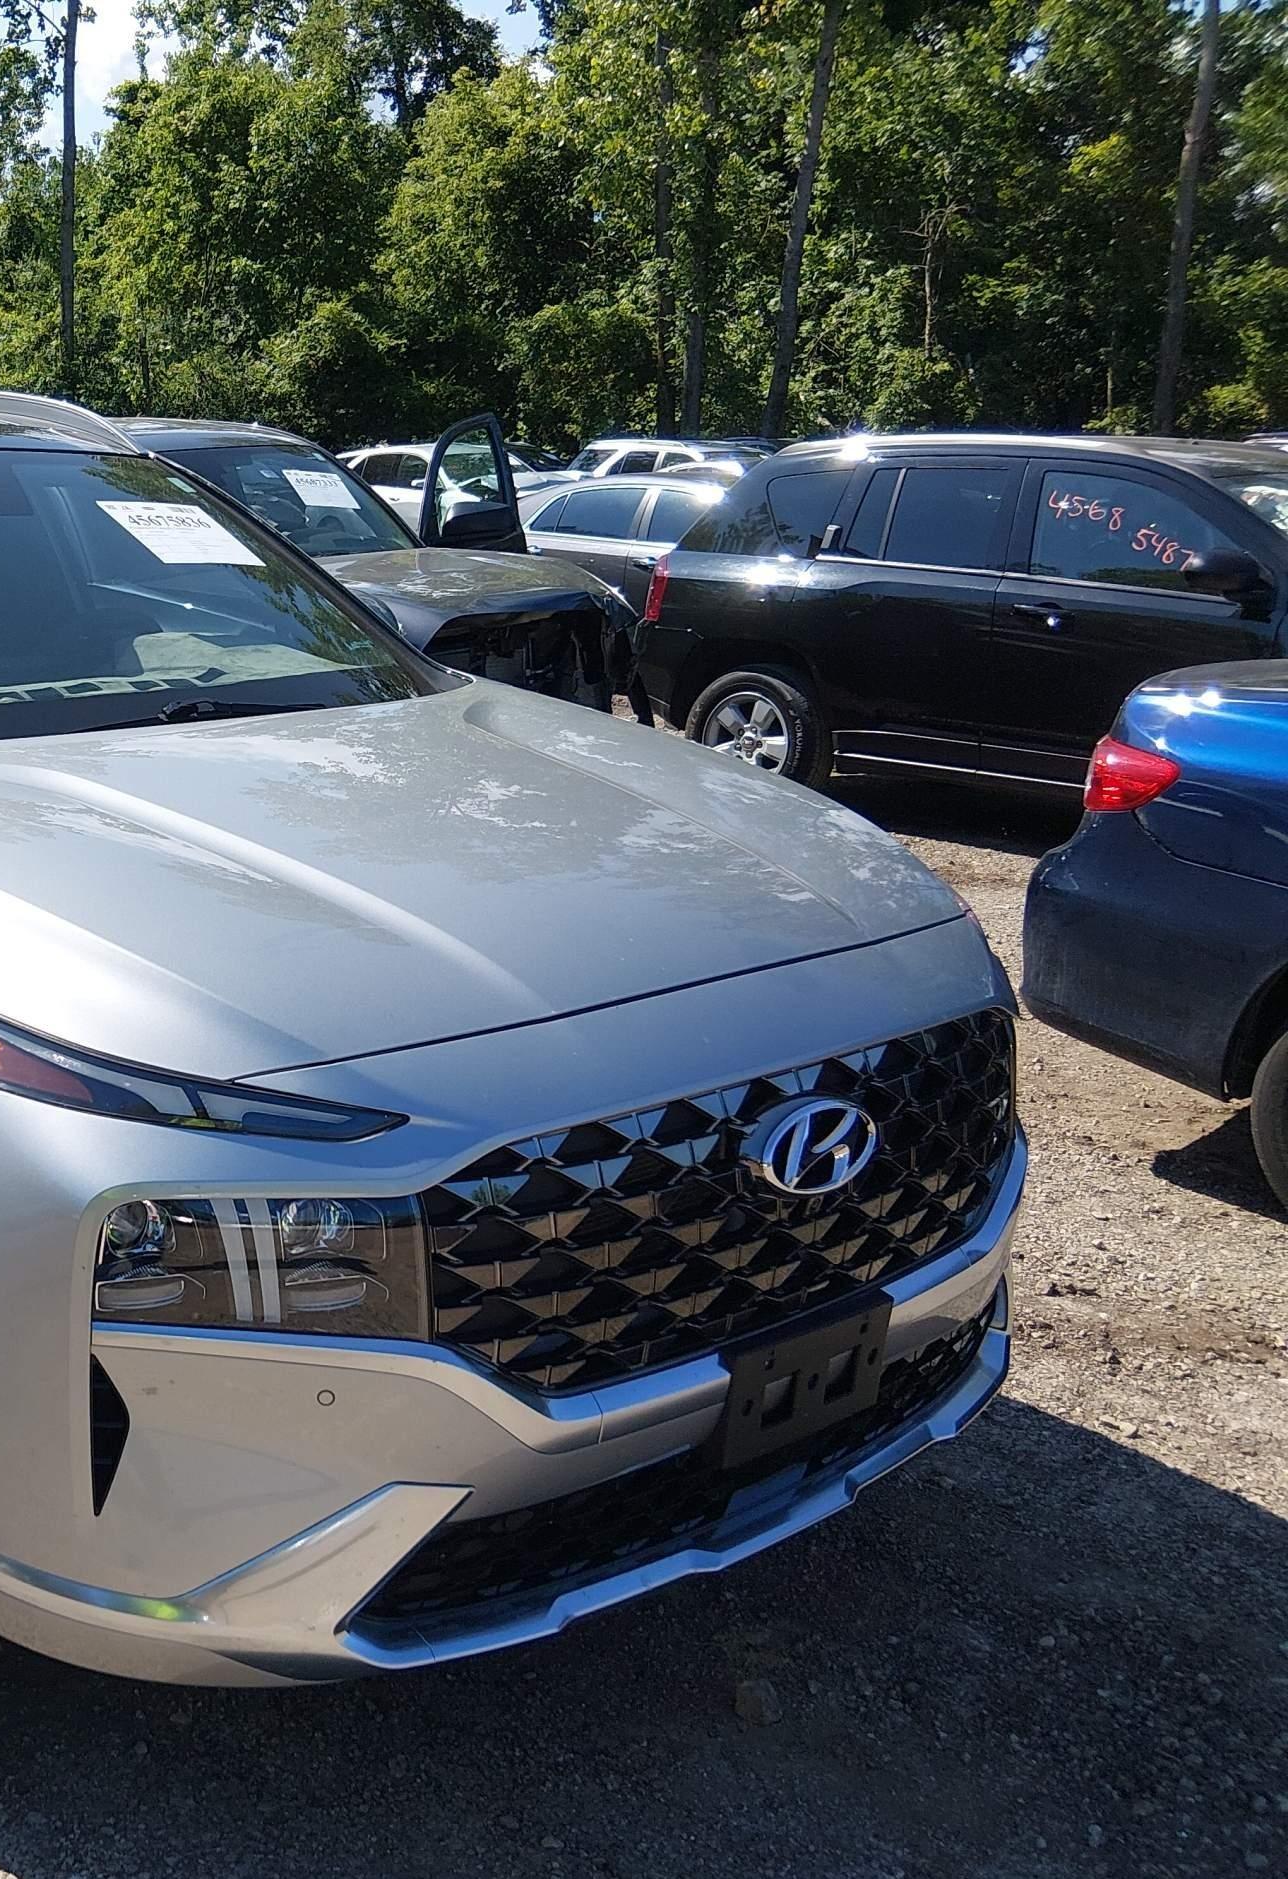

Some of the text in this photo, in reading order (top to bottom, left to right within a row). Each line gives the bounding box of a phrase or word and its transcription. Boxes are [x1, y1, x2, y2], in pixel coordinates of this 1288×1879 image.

[128, 514, 212, 529] 45675836
[1048, 490, 1195, 572] 4568 5487
